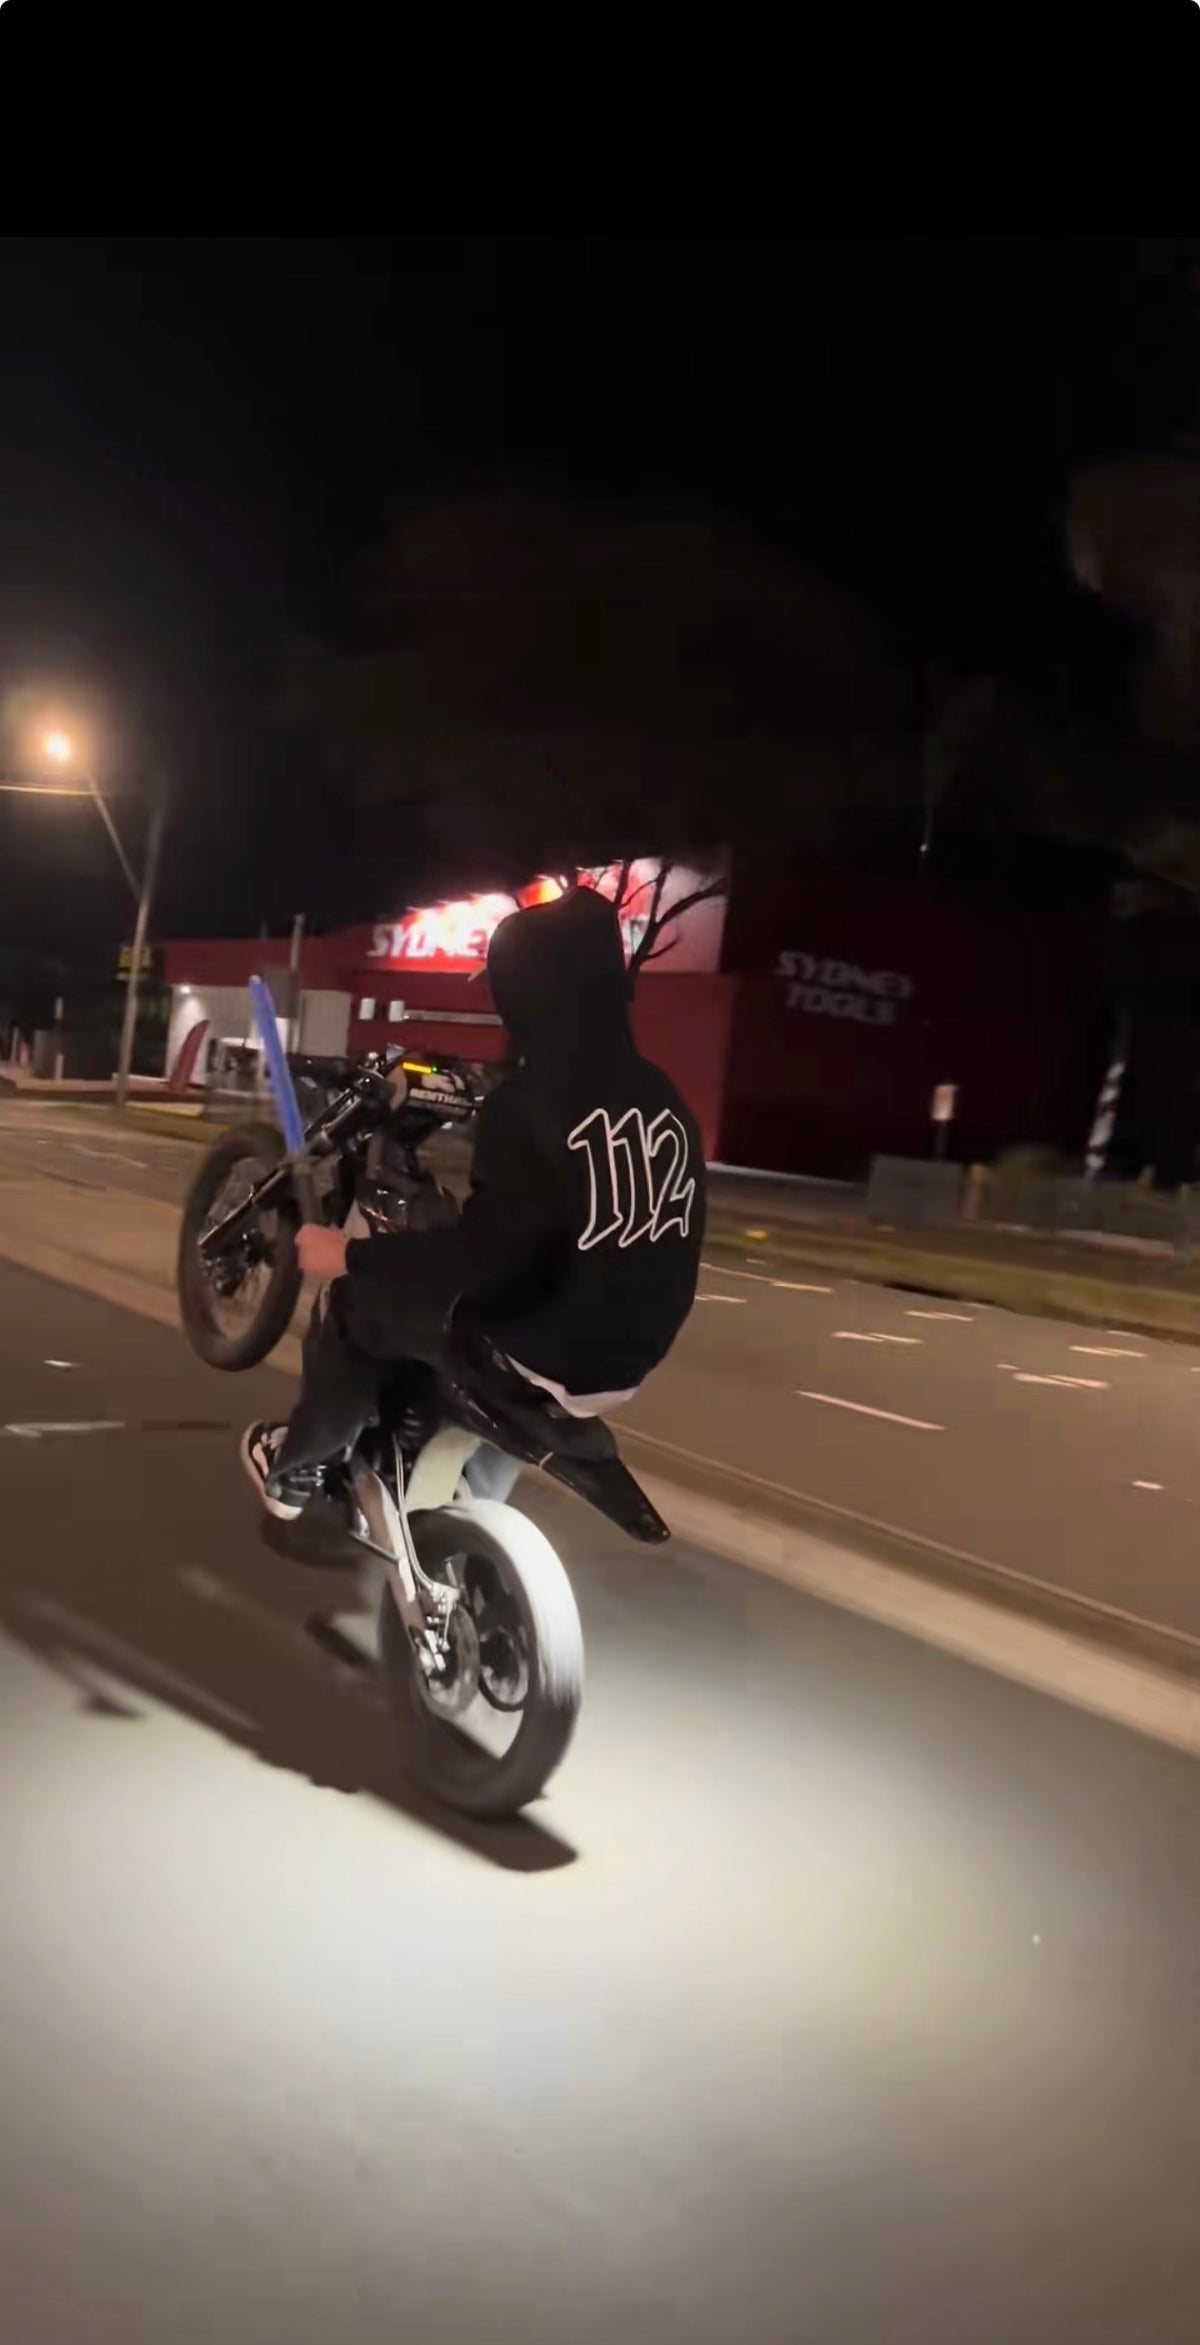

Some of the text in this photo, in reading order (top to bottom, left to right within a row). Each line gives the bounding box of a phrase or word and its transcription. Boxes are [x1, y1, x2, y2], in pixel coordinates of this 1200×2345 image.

[366, 921, 489, 958] SYDNE
[775, 951, 914, 999] SYDNEY
[787, 983, 895, 1025] TOOLS
[567, 1107, 696, 1251] 112
